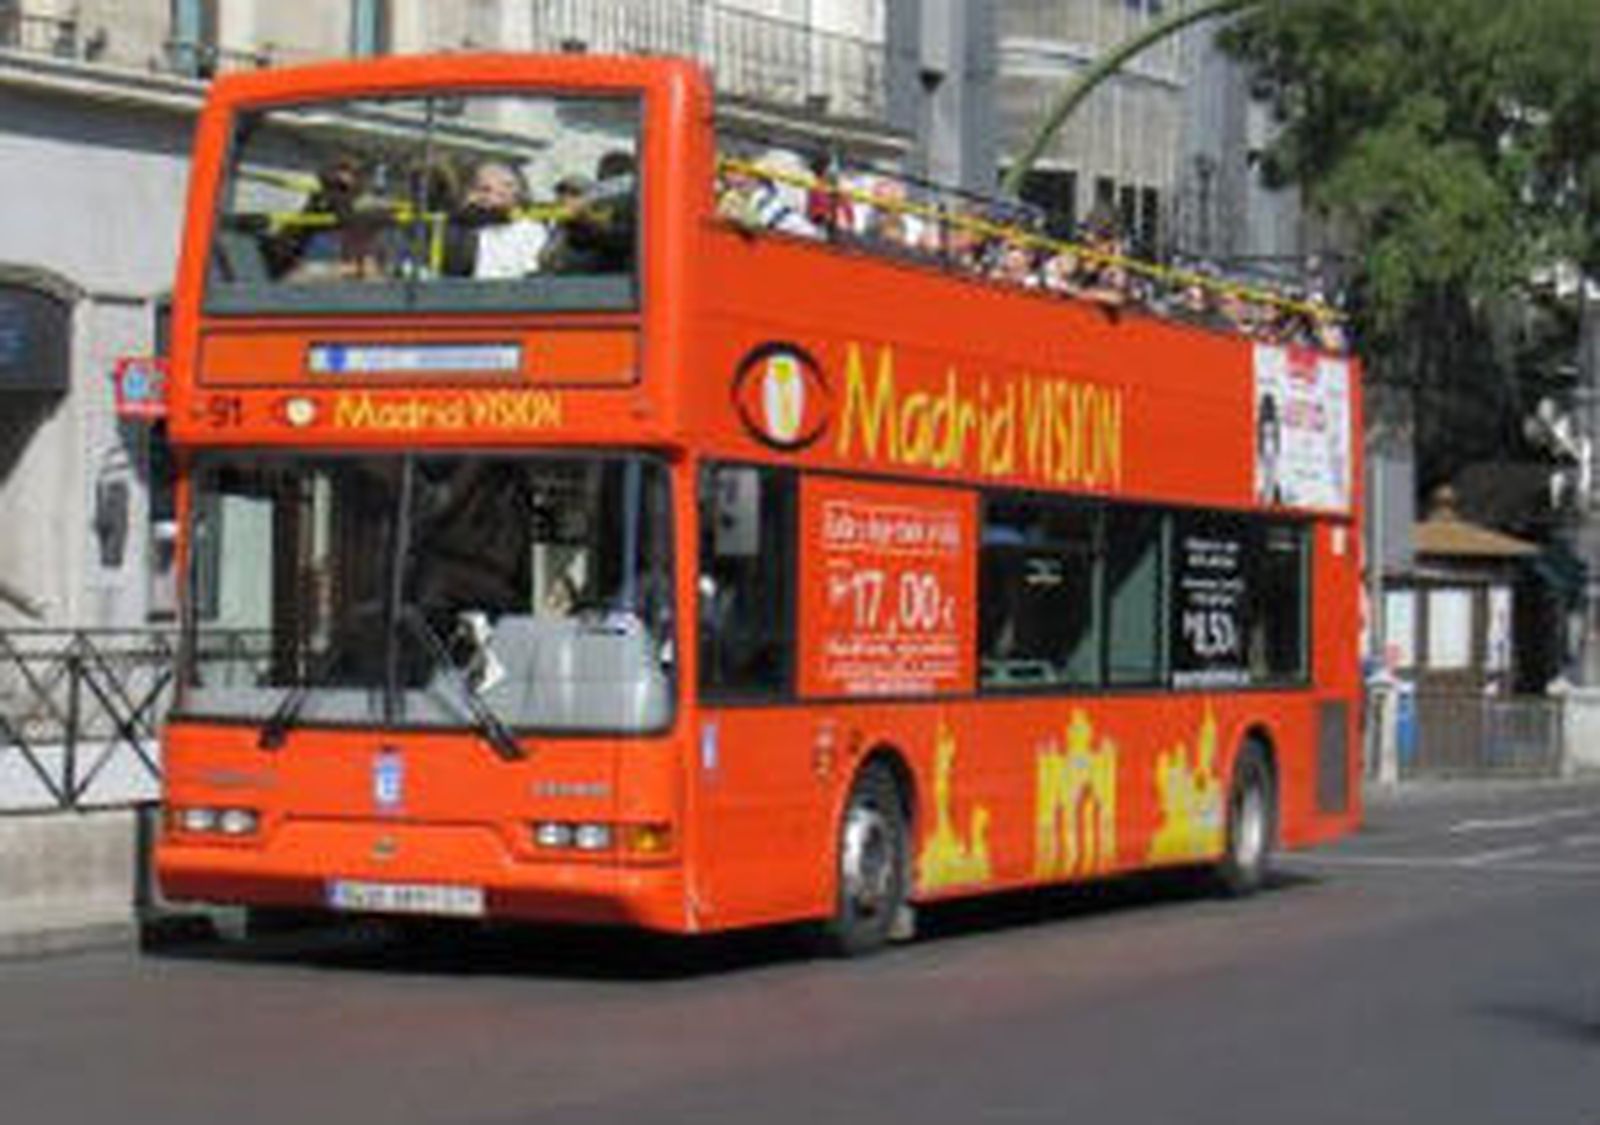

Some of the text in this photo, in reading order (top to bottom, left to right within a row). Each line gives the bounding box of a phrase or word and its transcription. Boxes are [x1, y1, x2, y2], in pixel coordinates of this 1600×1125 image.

[334, 389, 468, 428] Madrid
[837, 341, 1122, 489] Madrid VISION
